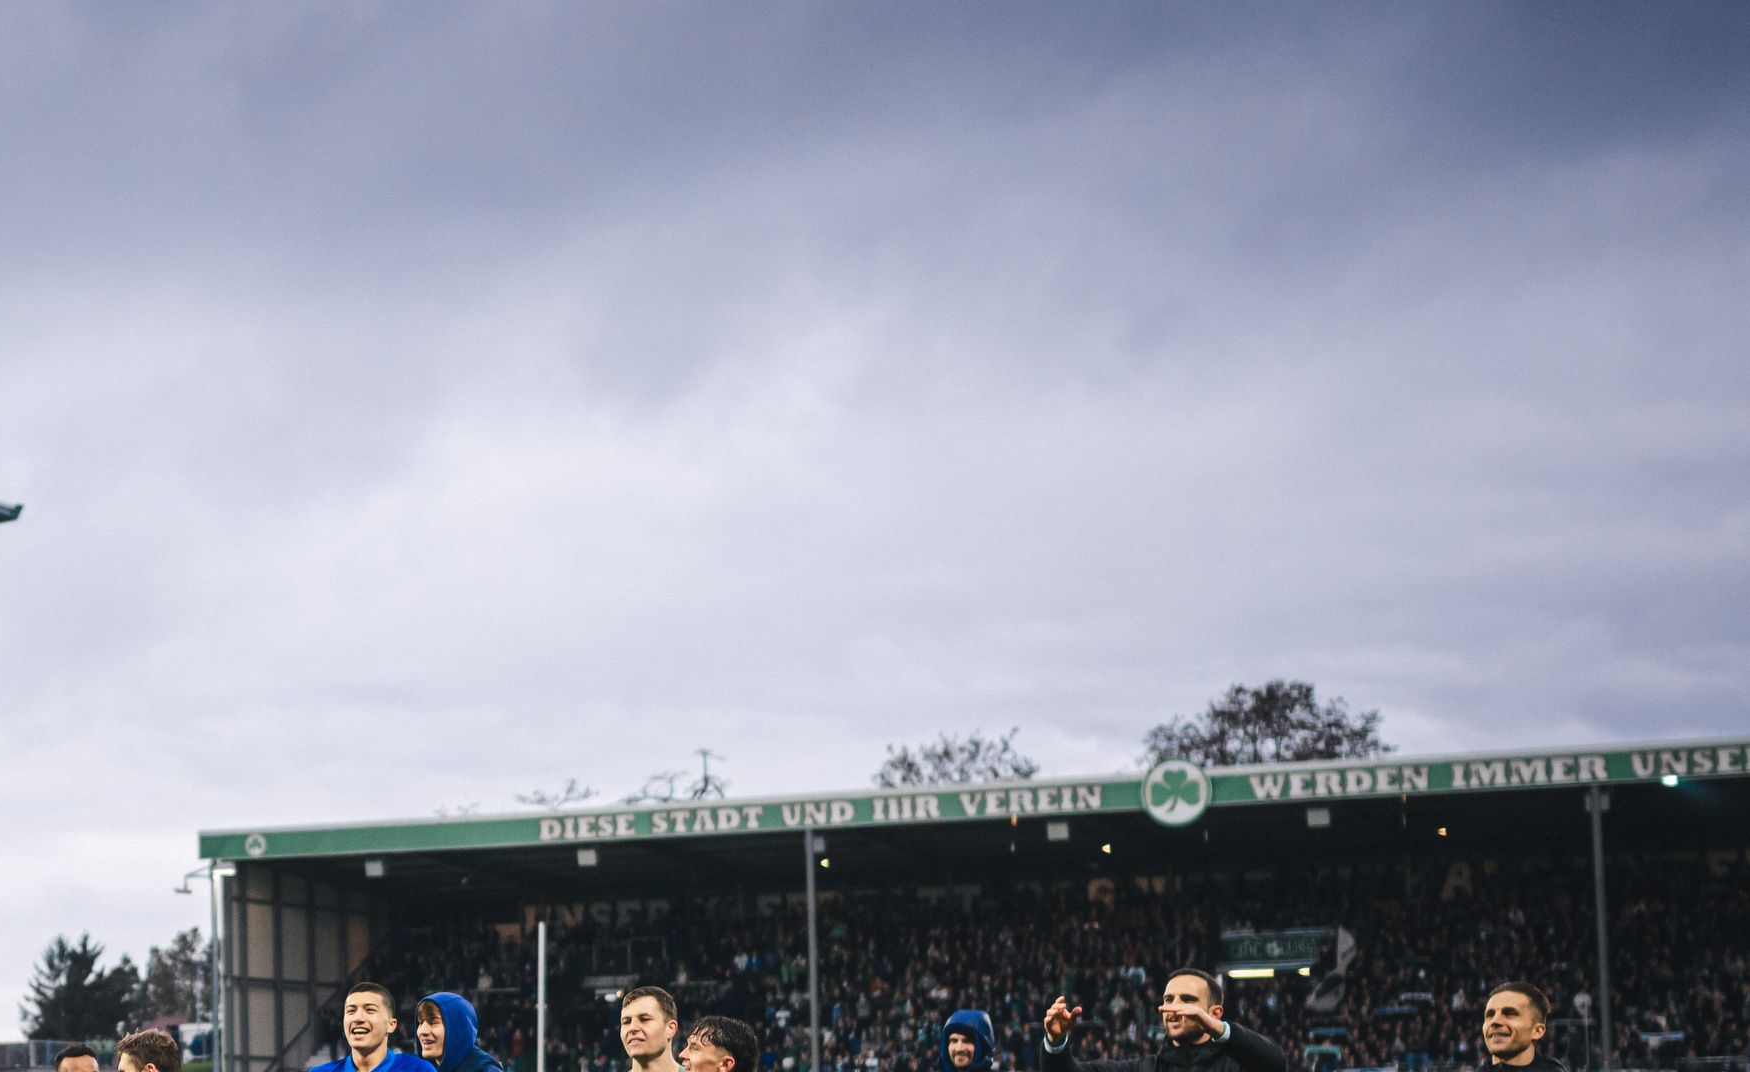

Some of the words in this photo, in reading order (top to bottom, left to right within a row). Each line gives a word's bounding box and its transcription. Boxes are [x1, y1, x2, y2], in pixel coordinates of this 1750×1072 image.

[1250, 765, 1429, 801] WERDEN
[1451, 754, 1608, 788] IMMER
[539, 814, 635, 841] DIESE
[652, 806, 763, 834] STADT
[782, 801, 854, 826] UND
[960, 784, 1102, 817] VEREIN
